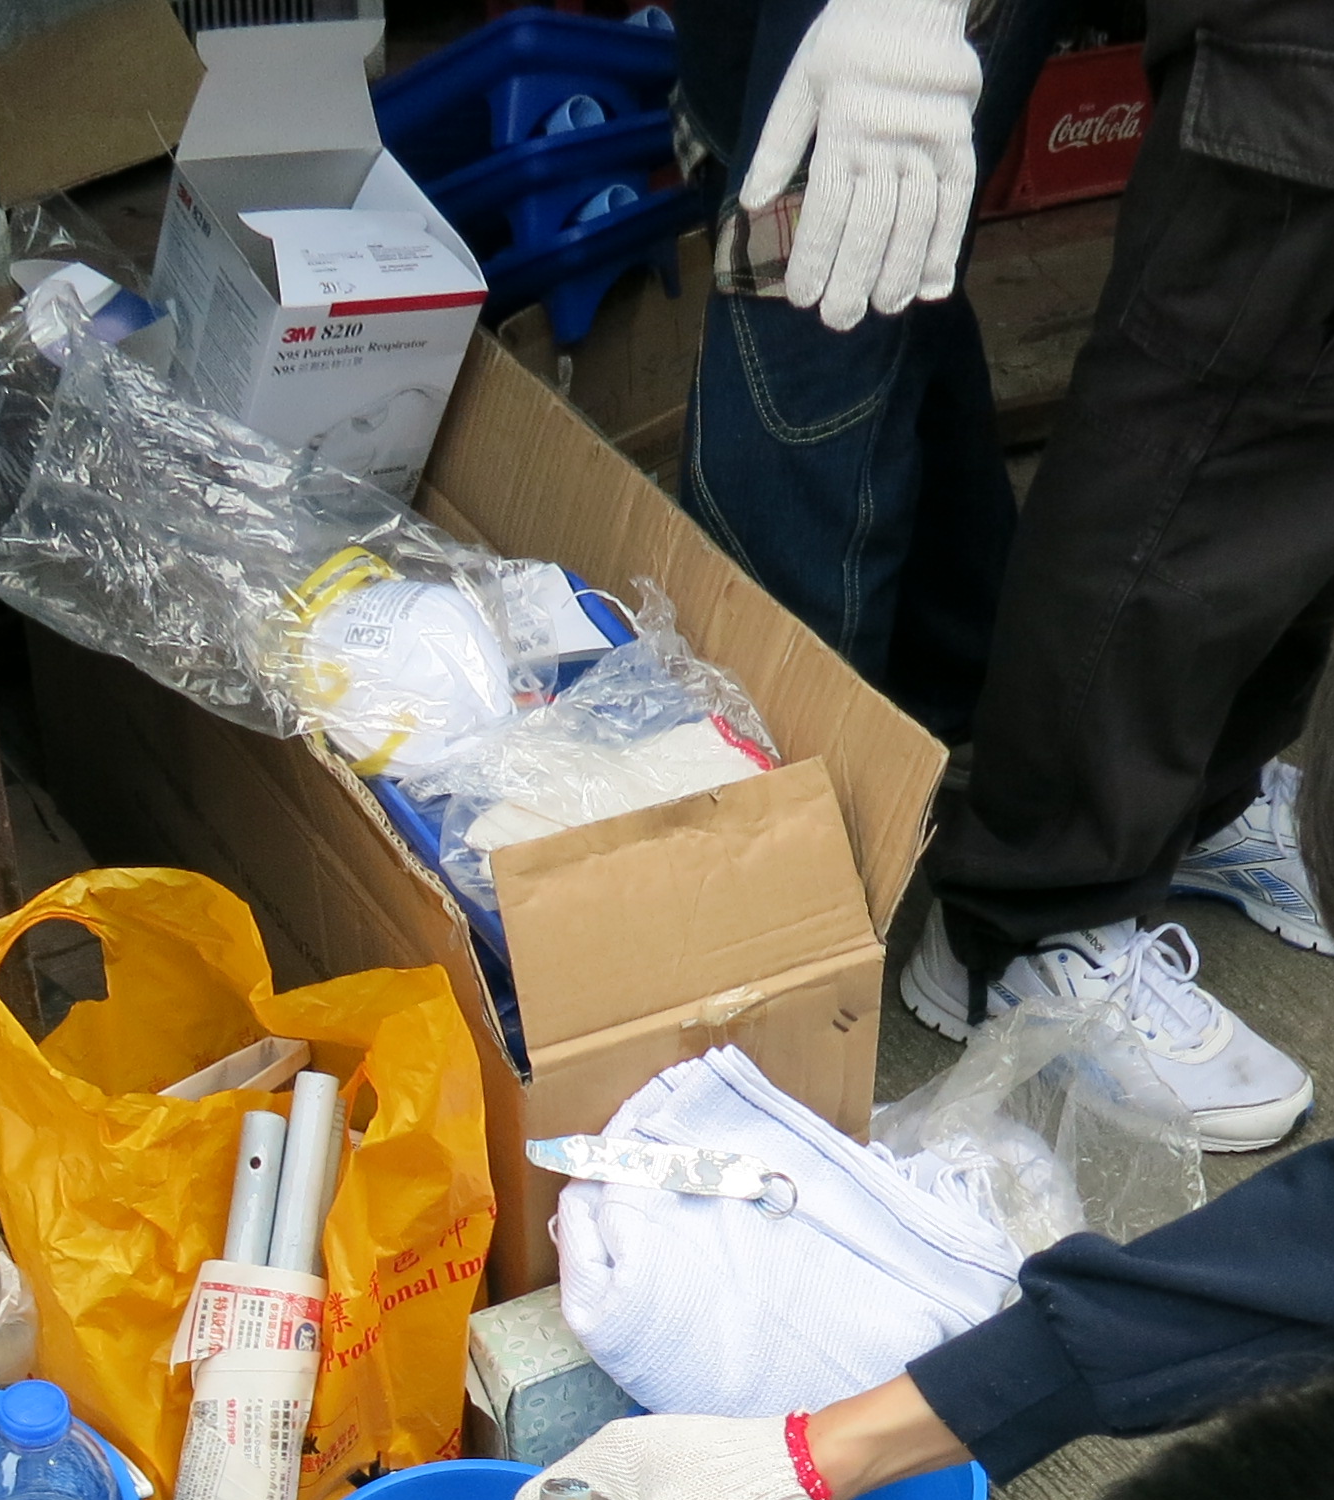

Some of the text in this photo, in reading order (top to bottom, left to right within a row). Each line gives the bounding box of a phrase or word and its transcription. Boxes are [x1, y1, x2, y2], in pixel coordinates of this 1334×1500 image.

[282, 321, 364, 344] 3M 8210
[276, 338, 428, 362] N95 Particulate Respirator
[350, 626, 386, 645] N95
[1080, 929, 1107, 954] eebok
